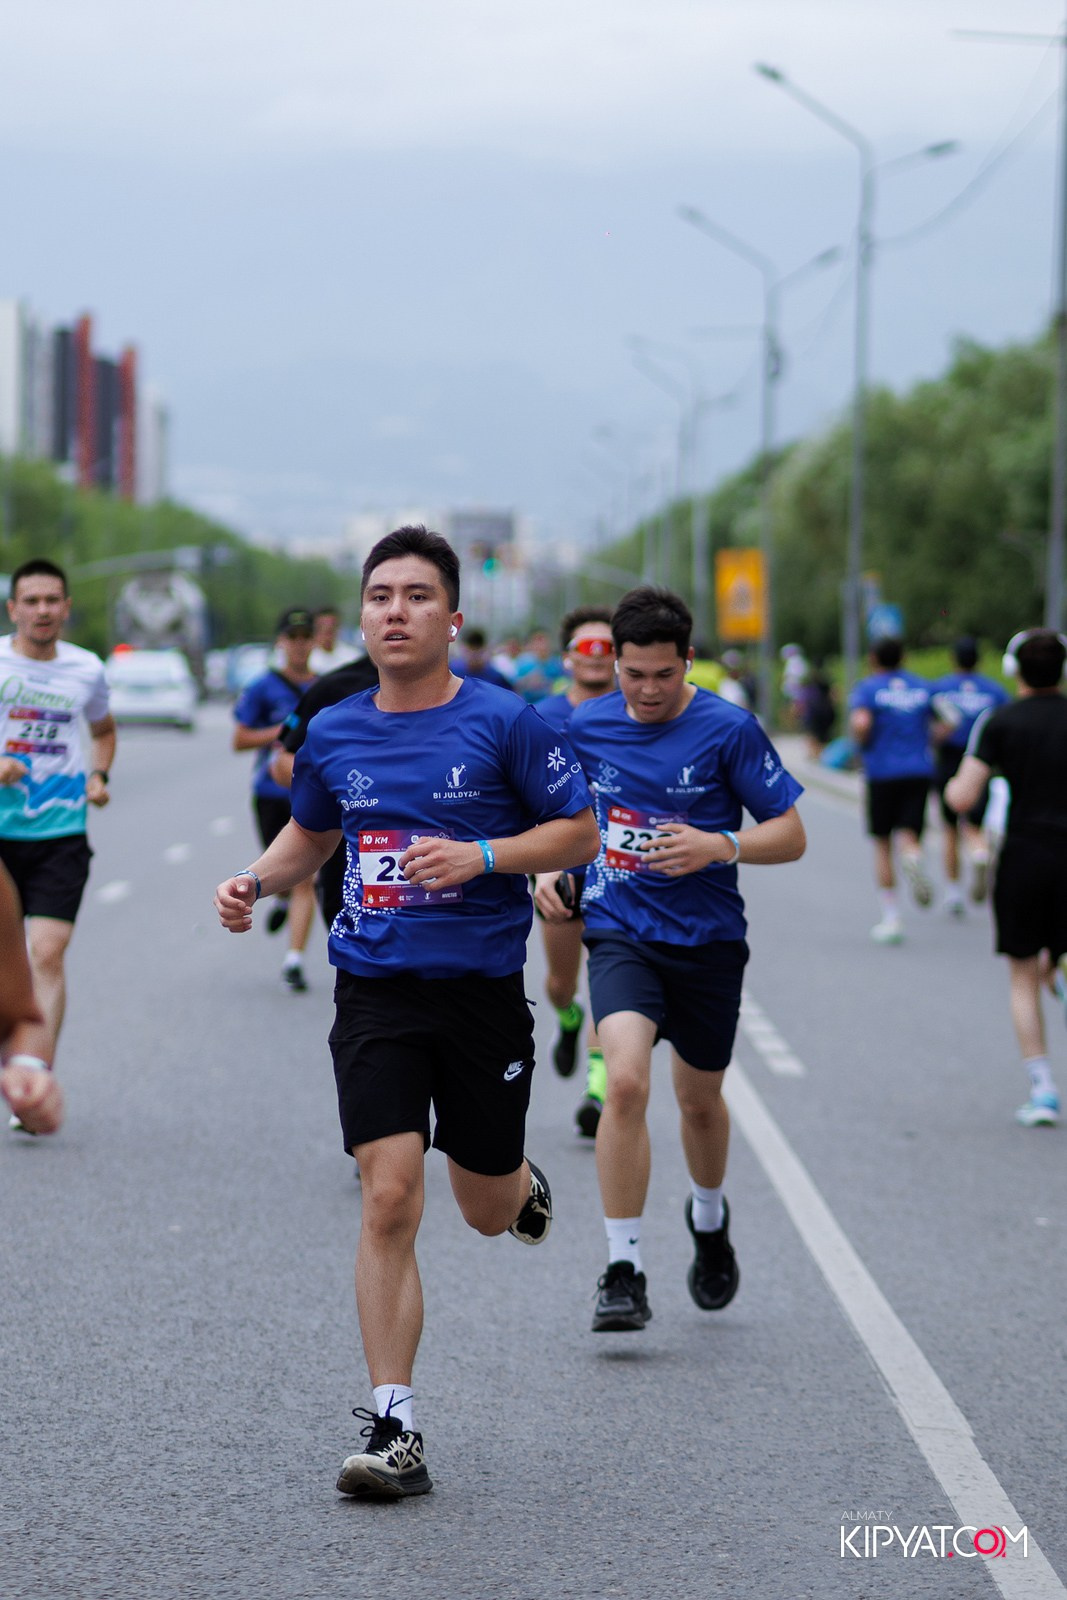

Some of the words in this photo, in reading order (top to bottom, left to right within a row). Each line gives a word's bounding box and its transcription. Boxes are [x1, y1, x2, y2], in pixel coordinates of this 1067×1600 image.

[20, 722, 57, 739] 258
[547, 772, 572, 794] Dream
[349, 798, 379, 809] GROUP
[362, 834, 373, 845] 10
[374, 836, 389, 845] KM
